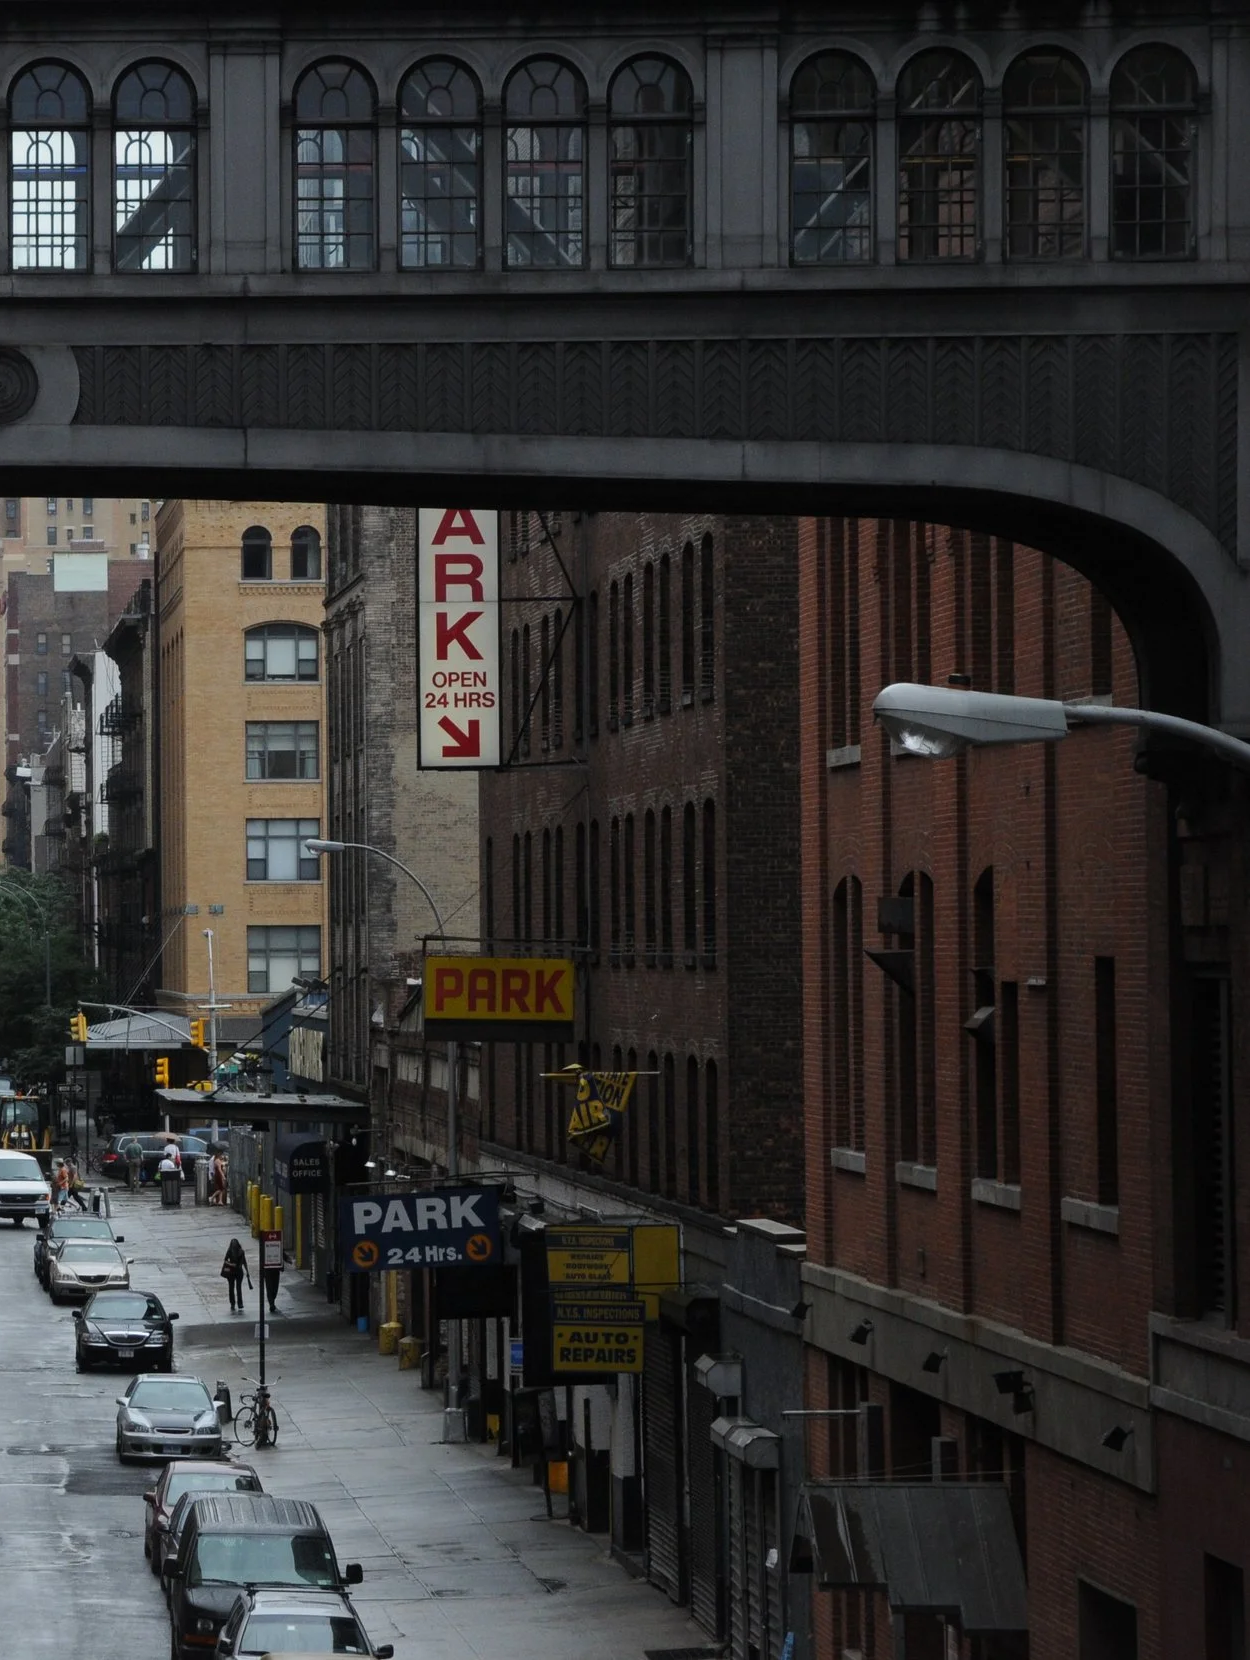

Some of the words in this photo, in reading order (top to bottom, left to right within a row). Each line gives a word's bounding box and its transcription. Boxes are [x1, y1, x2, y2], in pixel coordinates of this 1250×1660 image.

[431, 508, 486, 661] ARK
[432, 671, 487, 689] OPEN
[424, 692, 452, 709] 24
[454, 691, 495, 708] HRS
[434, 967, 566, 1013] PARK
[293, 1158, 321, 1166] SALES
[291, 1169, 323, 1178] OFFICE
[352, 1194, 486, 1235] PARK
[387, 1246, 422, 1264] 24
[424, 1245, 463, 1262] Hrs.
[583, 1307, 640, 1321] INSPECTIONS
[569, 1331, 629, 1344] AUTO
[559, 1347, 636, 1365] REPAIRS
